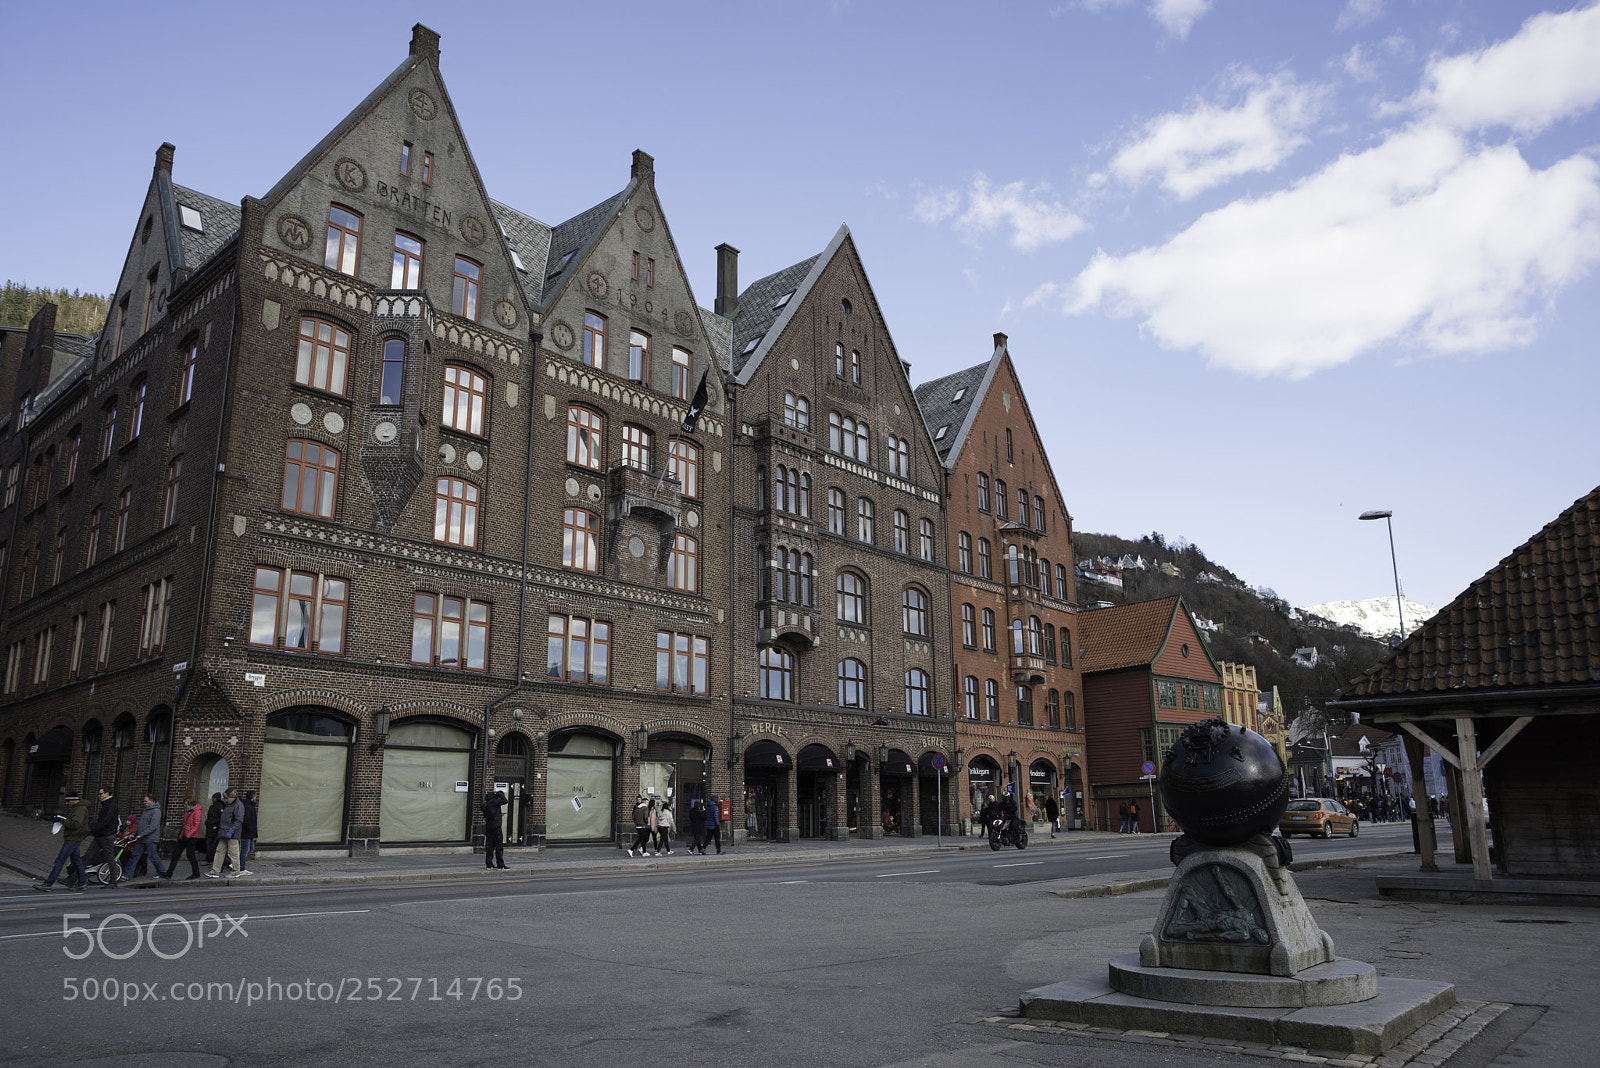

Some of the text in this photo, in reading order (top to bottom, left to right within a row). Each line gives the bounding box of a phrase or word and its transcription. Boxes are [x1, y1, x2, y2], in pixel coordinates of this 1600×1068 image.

[376, 180, 452, 226] BRATTEN
[616, 288, 668, 321] 1904
[751, 722, 783, 737] BERLE
[921, 736, 944, 748] BERLE
